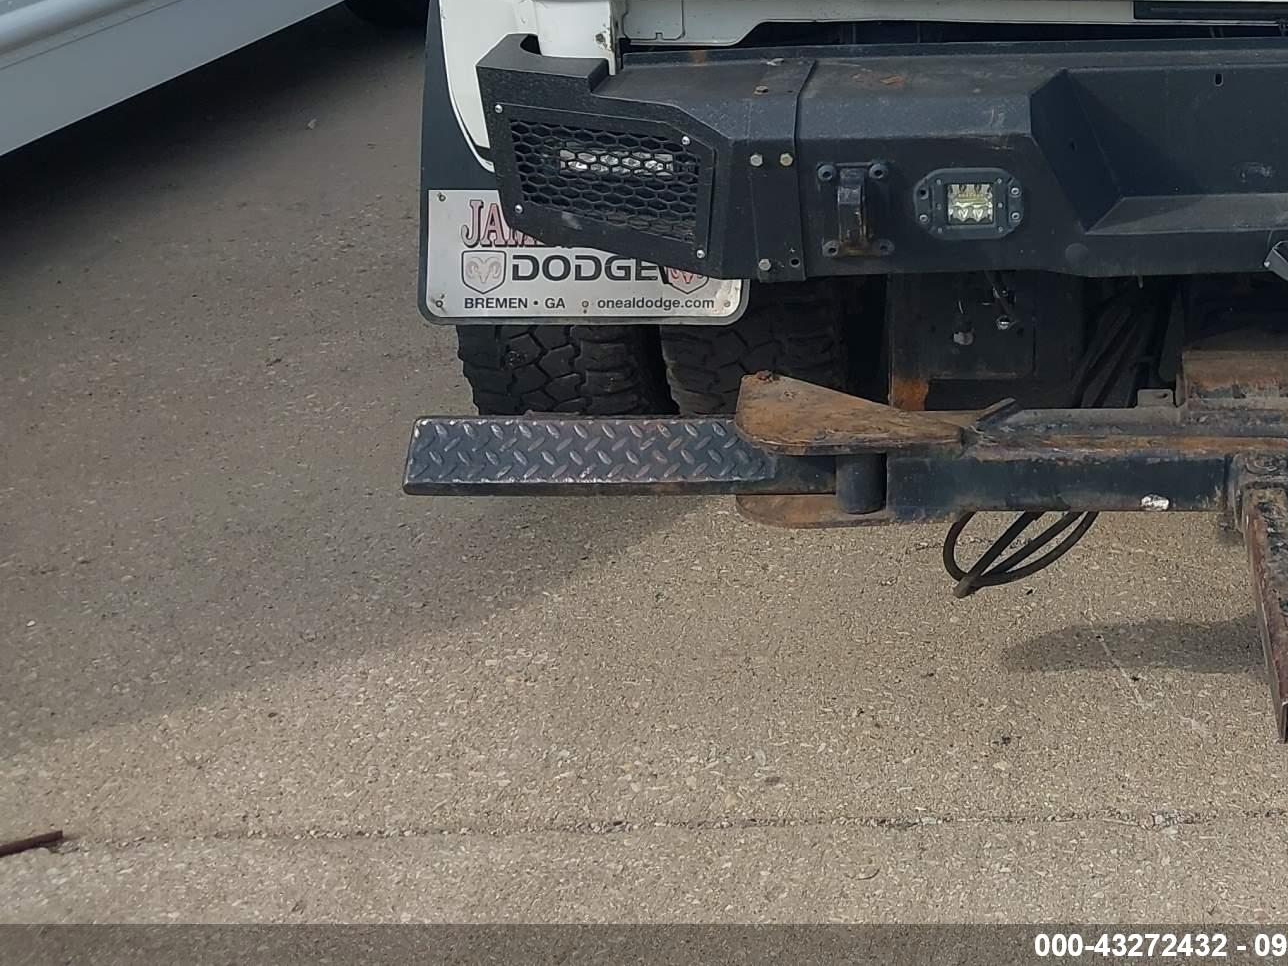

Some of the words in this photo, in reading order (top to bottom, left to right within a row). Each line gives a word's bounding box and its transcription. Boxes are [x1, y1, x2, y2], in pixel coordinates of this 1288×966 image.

[511, 254, 660, 282] DODGE
[464, 297, 528, 309] BREMEN
[544, 297, 566, 309] GA
[597, 296, 715, 311] onealdodge.com
